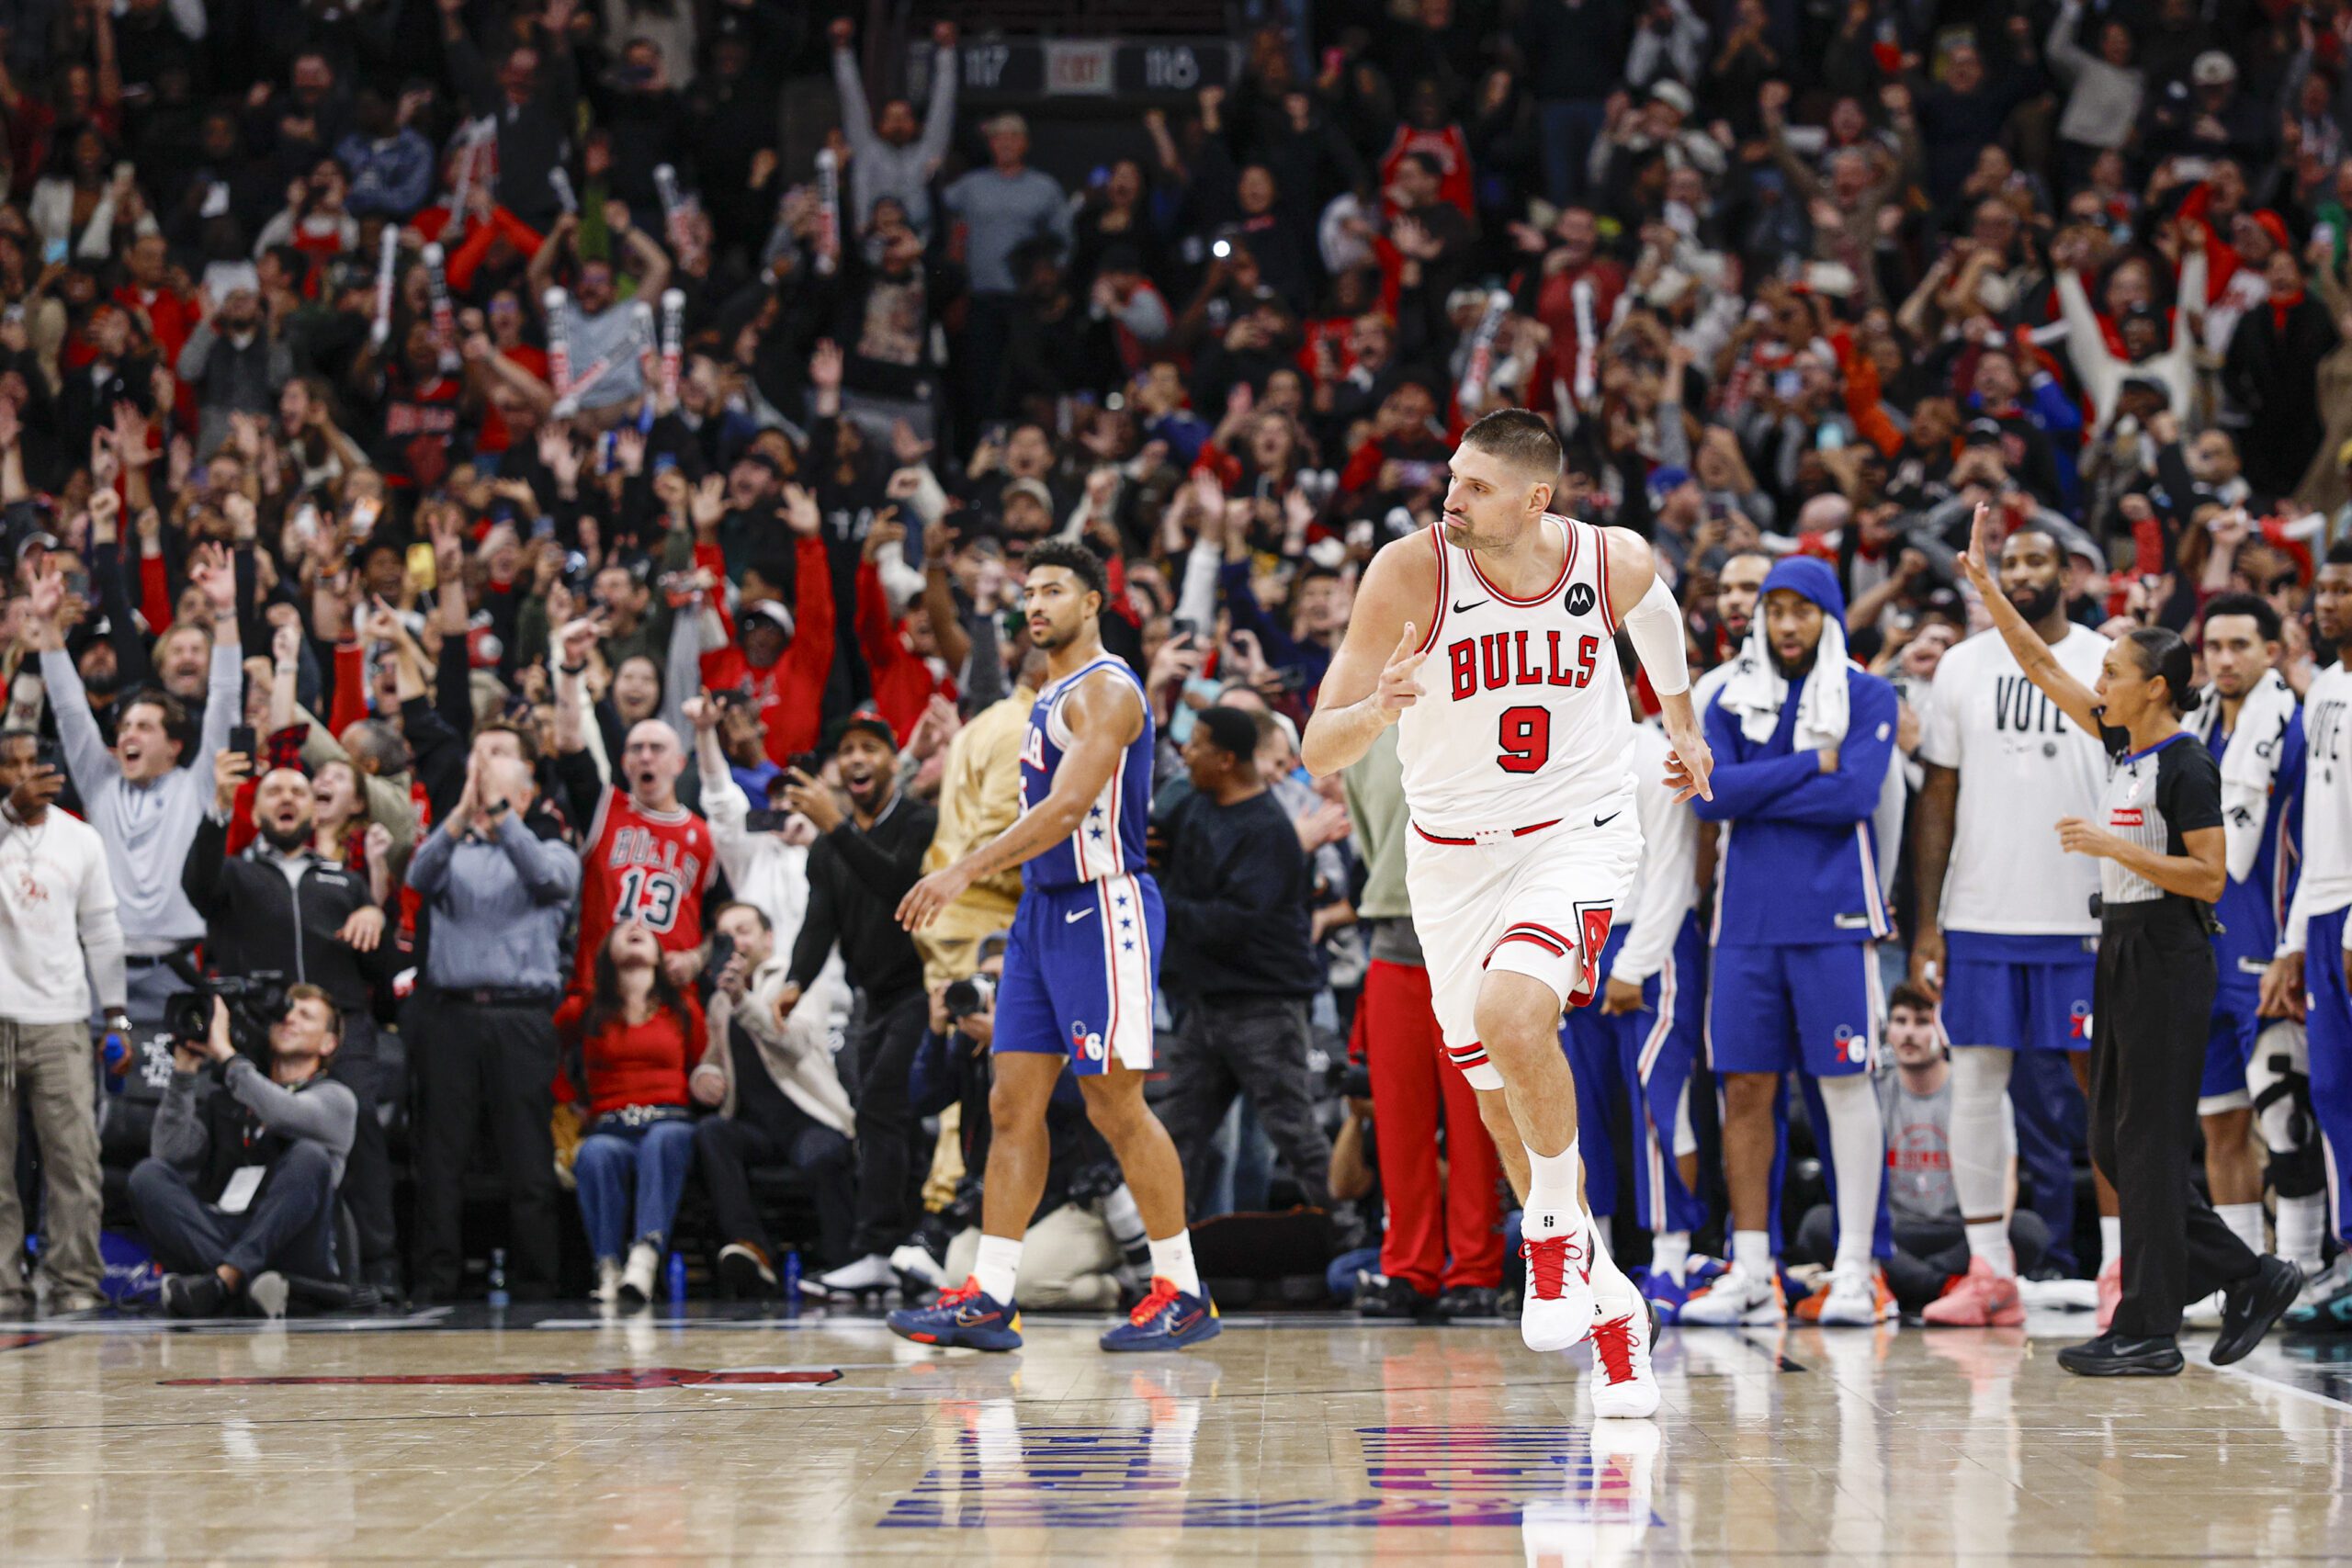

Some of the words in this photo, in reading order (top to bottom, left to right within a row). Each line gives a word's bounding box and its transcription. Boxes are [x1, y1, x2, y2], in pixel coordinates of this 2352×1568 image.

[1448, 630, 1600, 702] BULLS
[1497, 705, 1551, 773] 9
[612, 865, 683, 934] 13
[1072, 1032, 1103, 1061] 76
[1834, 1034, 1866, 1064] 76
